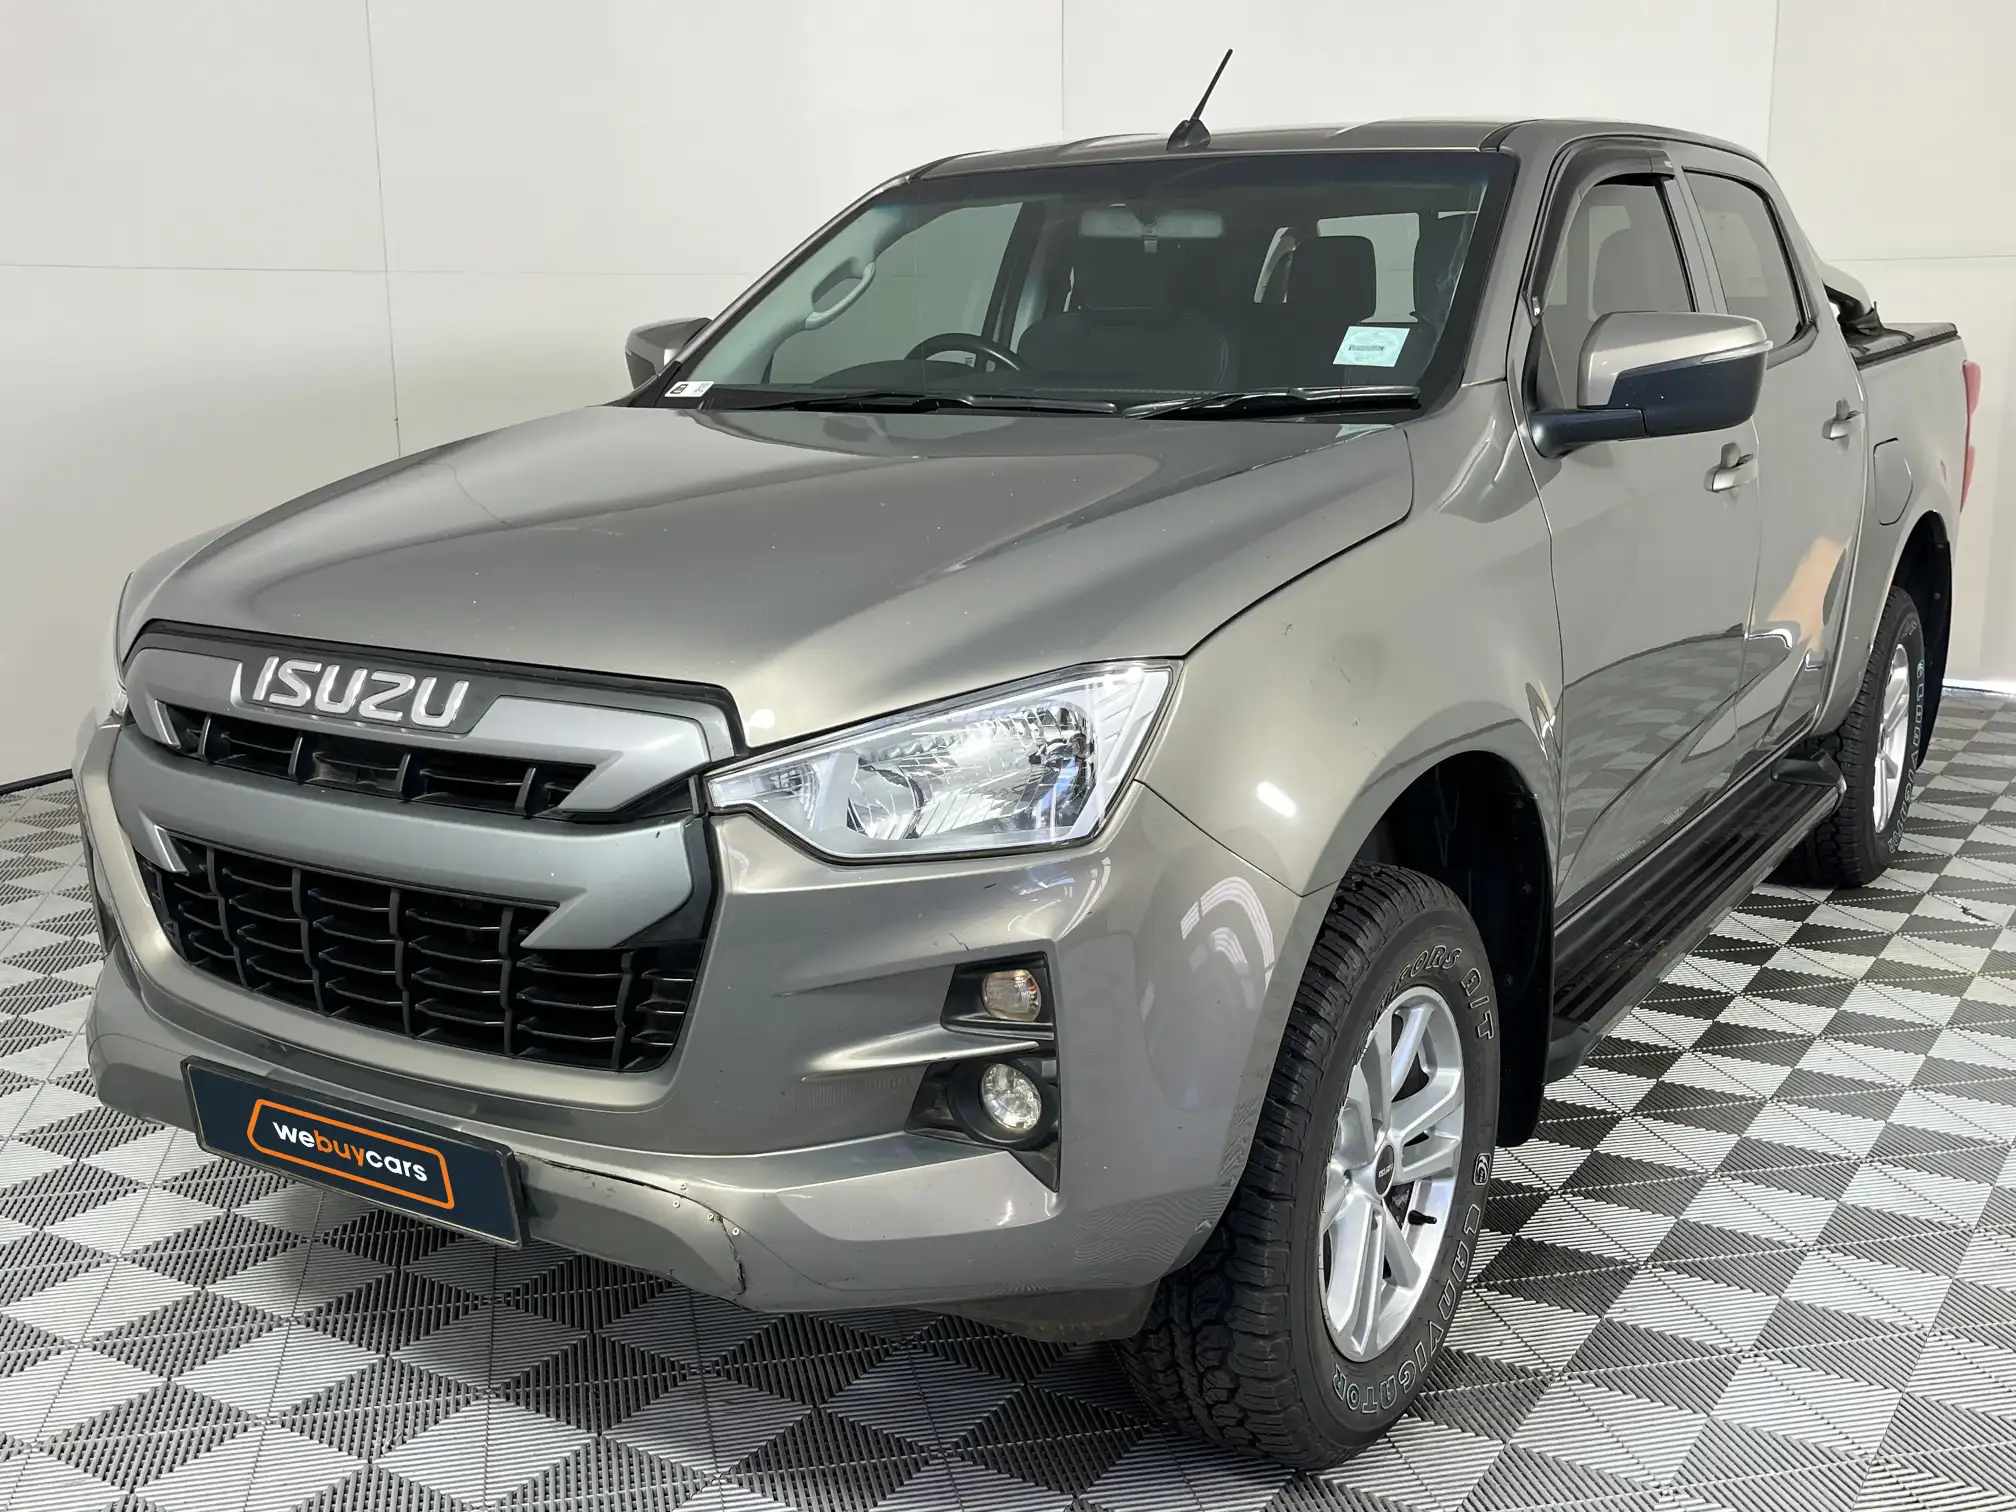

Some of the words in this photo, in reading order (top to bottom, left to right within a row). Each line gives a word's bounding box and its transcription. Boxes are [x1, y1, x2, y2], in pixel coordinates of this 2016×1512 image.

[252, 656, 470, 728] ISUZU
[1460, 967, 1495, 1040] A/T
[272, 1121, 428, 1182] webuycars
[1332, 1204, 1481, 1414] LANVIGATOR
